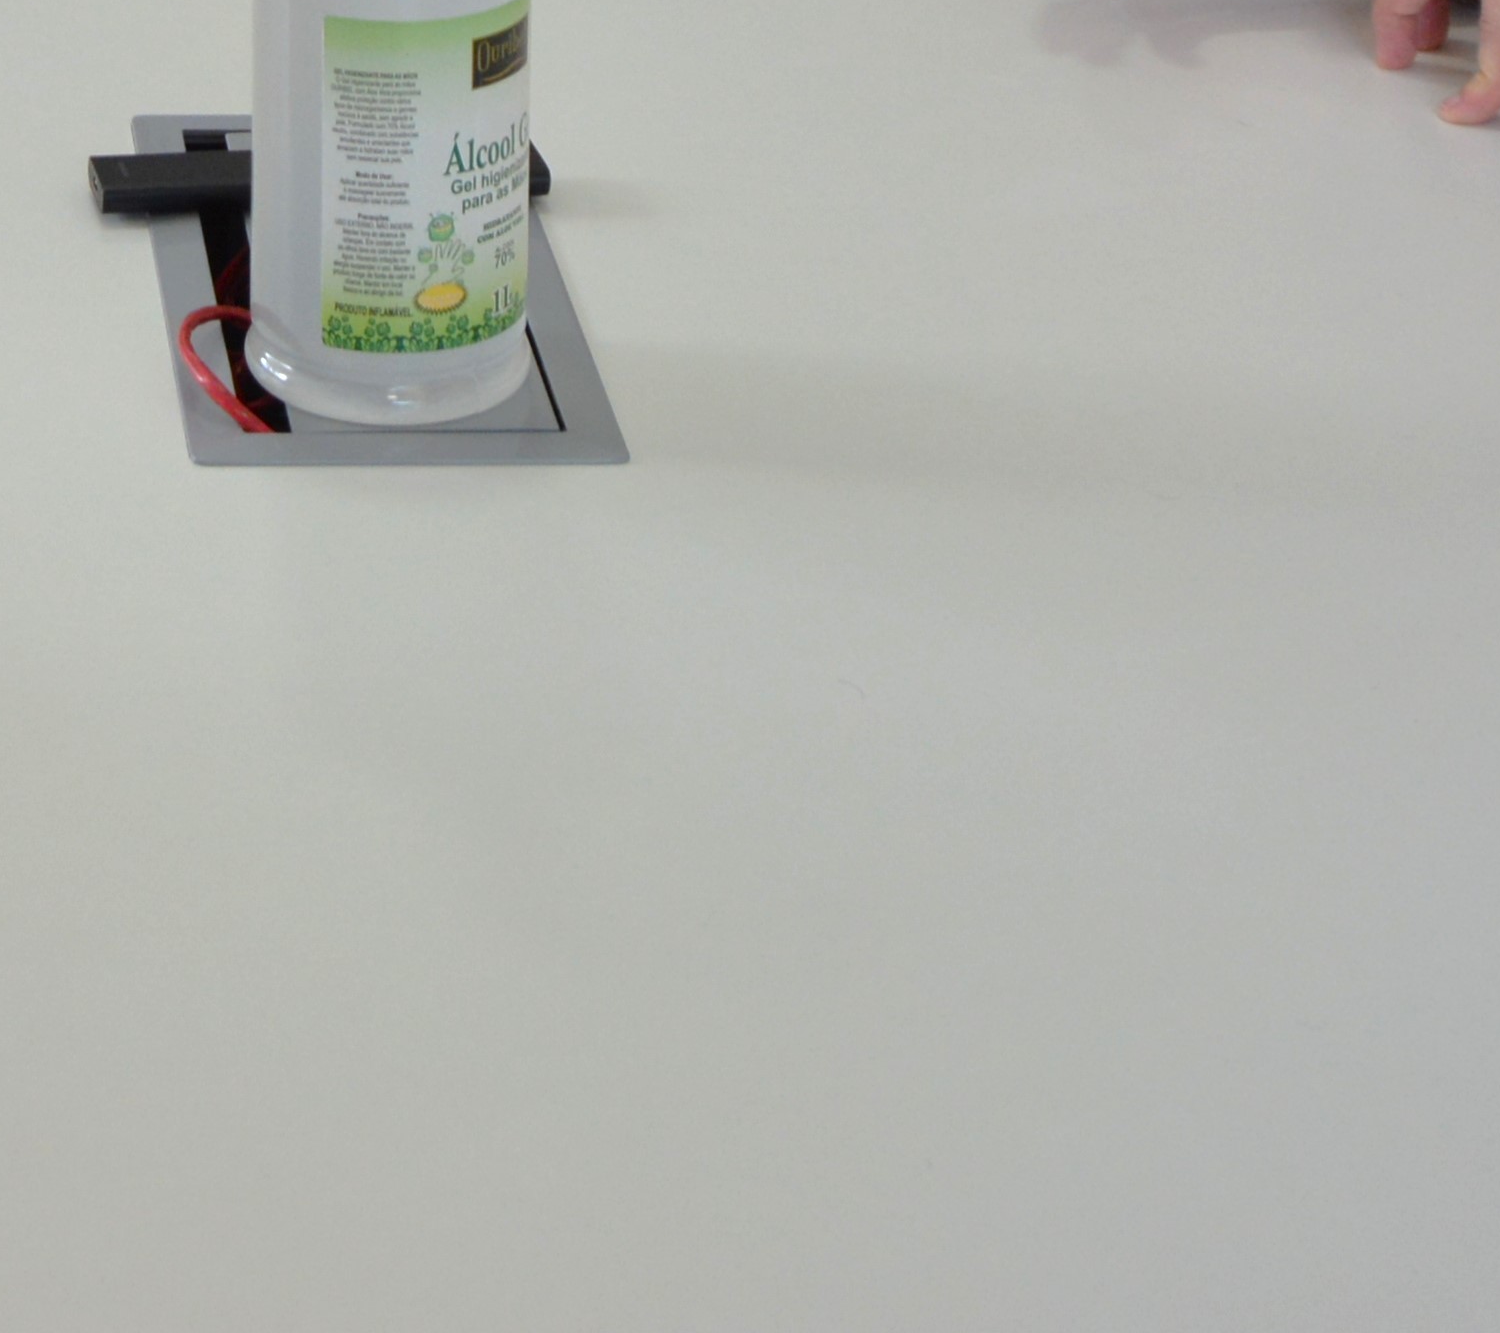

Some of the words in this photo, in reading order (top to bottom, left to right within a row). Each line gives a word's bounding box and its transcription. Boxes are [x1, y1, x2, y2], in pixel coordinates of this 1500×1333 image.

[443, 122, 516, 176] Álcool
[451, 175, 477, 195] Gel
[462, 191, 493, 215] para
[496, 184, 509, 200] as
